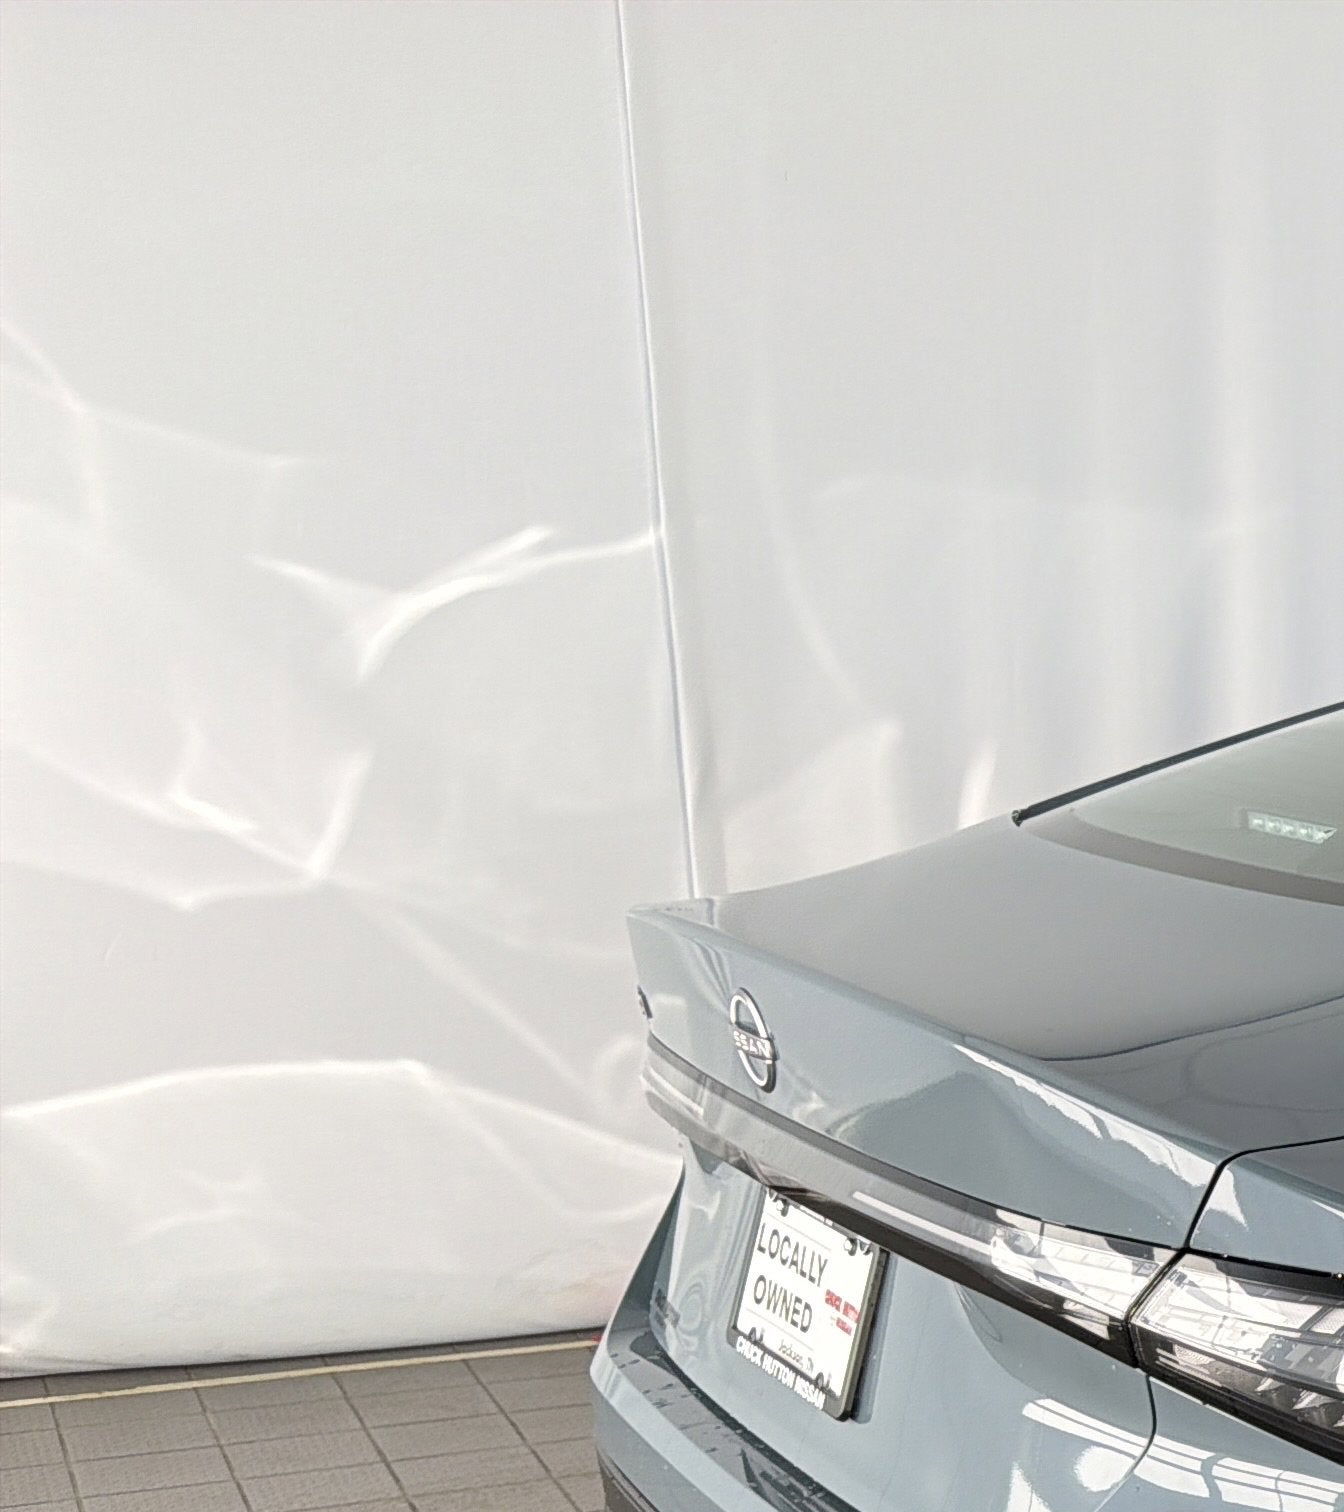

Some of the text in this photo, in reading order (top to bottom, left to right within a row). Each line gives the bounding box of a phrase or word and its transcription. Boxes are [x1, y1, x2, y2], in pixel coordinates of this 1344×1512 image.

[756, 1223, 828, 1287] LOCALLY
[753, 1275, 813, 1333] OWNED
[736, 1336, 826, 1410] CHUCK HUTTON NISSAN
